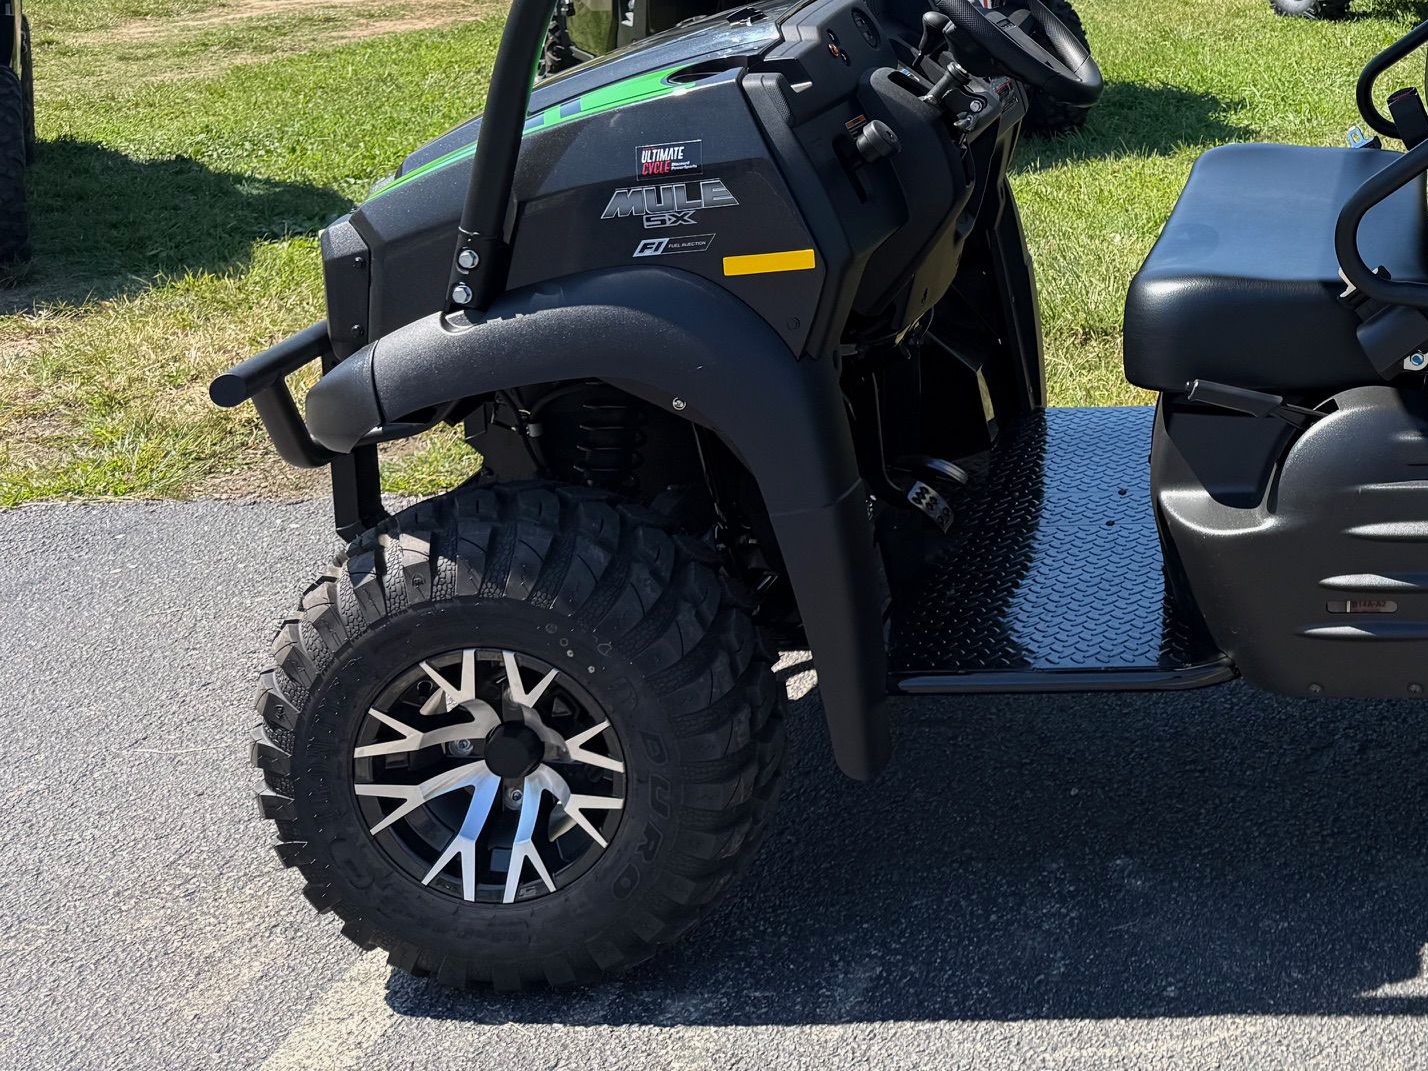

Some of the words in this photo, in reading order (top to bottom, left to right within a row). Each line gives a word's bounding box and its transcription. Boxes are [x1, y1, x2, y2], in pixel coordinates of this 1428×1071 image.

[641, 146, 685, 164] ULTIMATE
[642, 160, 671, 176] CYCLE
[600, 179, 740, 219] MULE
[642, 209, 698, 229] SX
[638, 241, 664, 254] FI
[612, 729, 673, 901] DURO
